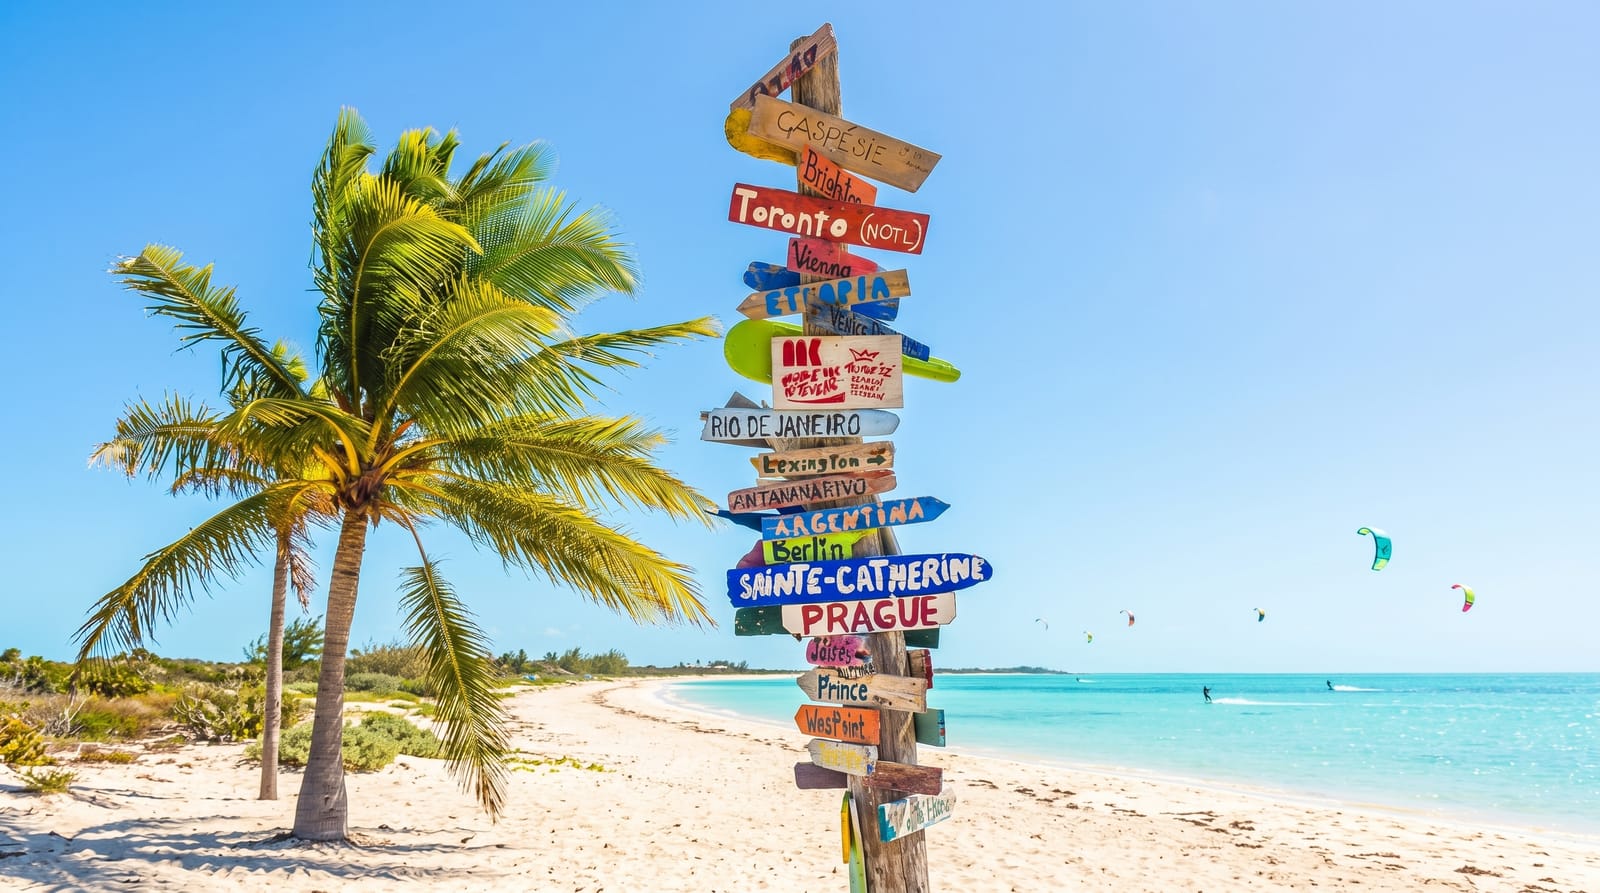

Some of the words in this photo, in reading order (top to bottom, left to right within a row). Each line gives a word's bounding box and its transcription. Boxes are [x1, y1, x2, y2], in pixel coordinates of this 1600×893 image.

[735, 187, 848, 238] Toronto
[860, 212, 922, 252] (NOTL)
[792, 240, 851, 278] Vienna
[711, 415, 741, 438] RIO
[747, 415, 771, 437] DE
[775, 413, 861, 438] JANEIRO
[763, 454, 860, 474] Lexington
[732, 478, 867, 510] ANTANANARIVO
[775, 499, 925, 537] ARGENTINA
[772, 536, 844, 562] Berlin
[739, 553, 985, 601] SAINTE-CATHERINE
[801, 595, 940, 636] PRAGUE
[817, 674, 868, 702] Prince
